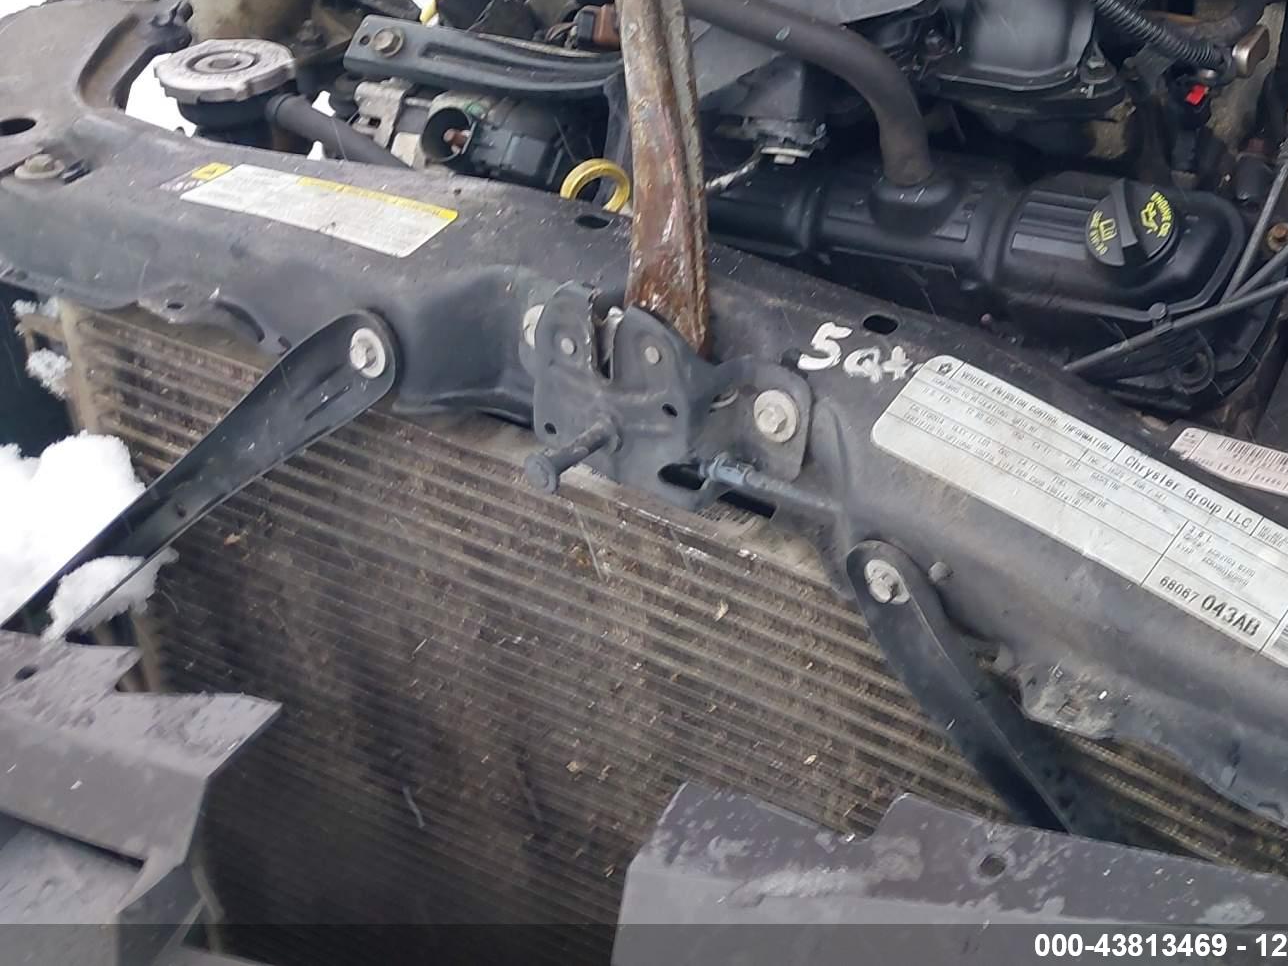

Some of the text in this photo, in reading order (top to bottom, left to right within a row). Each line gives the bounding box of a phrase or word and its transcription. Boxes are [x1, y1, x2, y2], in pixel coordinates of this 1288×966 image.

[1061, 421, 1112, 454] INFORMATION
[1124, 455, 1180, 491] Chrysler
[1185, 486, 1223, 514] Group
[1223, 505, 1253, 529] LLC
[1201, 594, 1261, 637] 043AB
